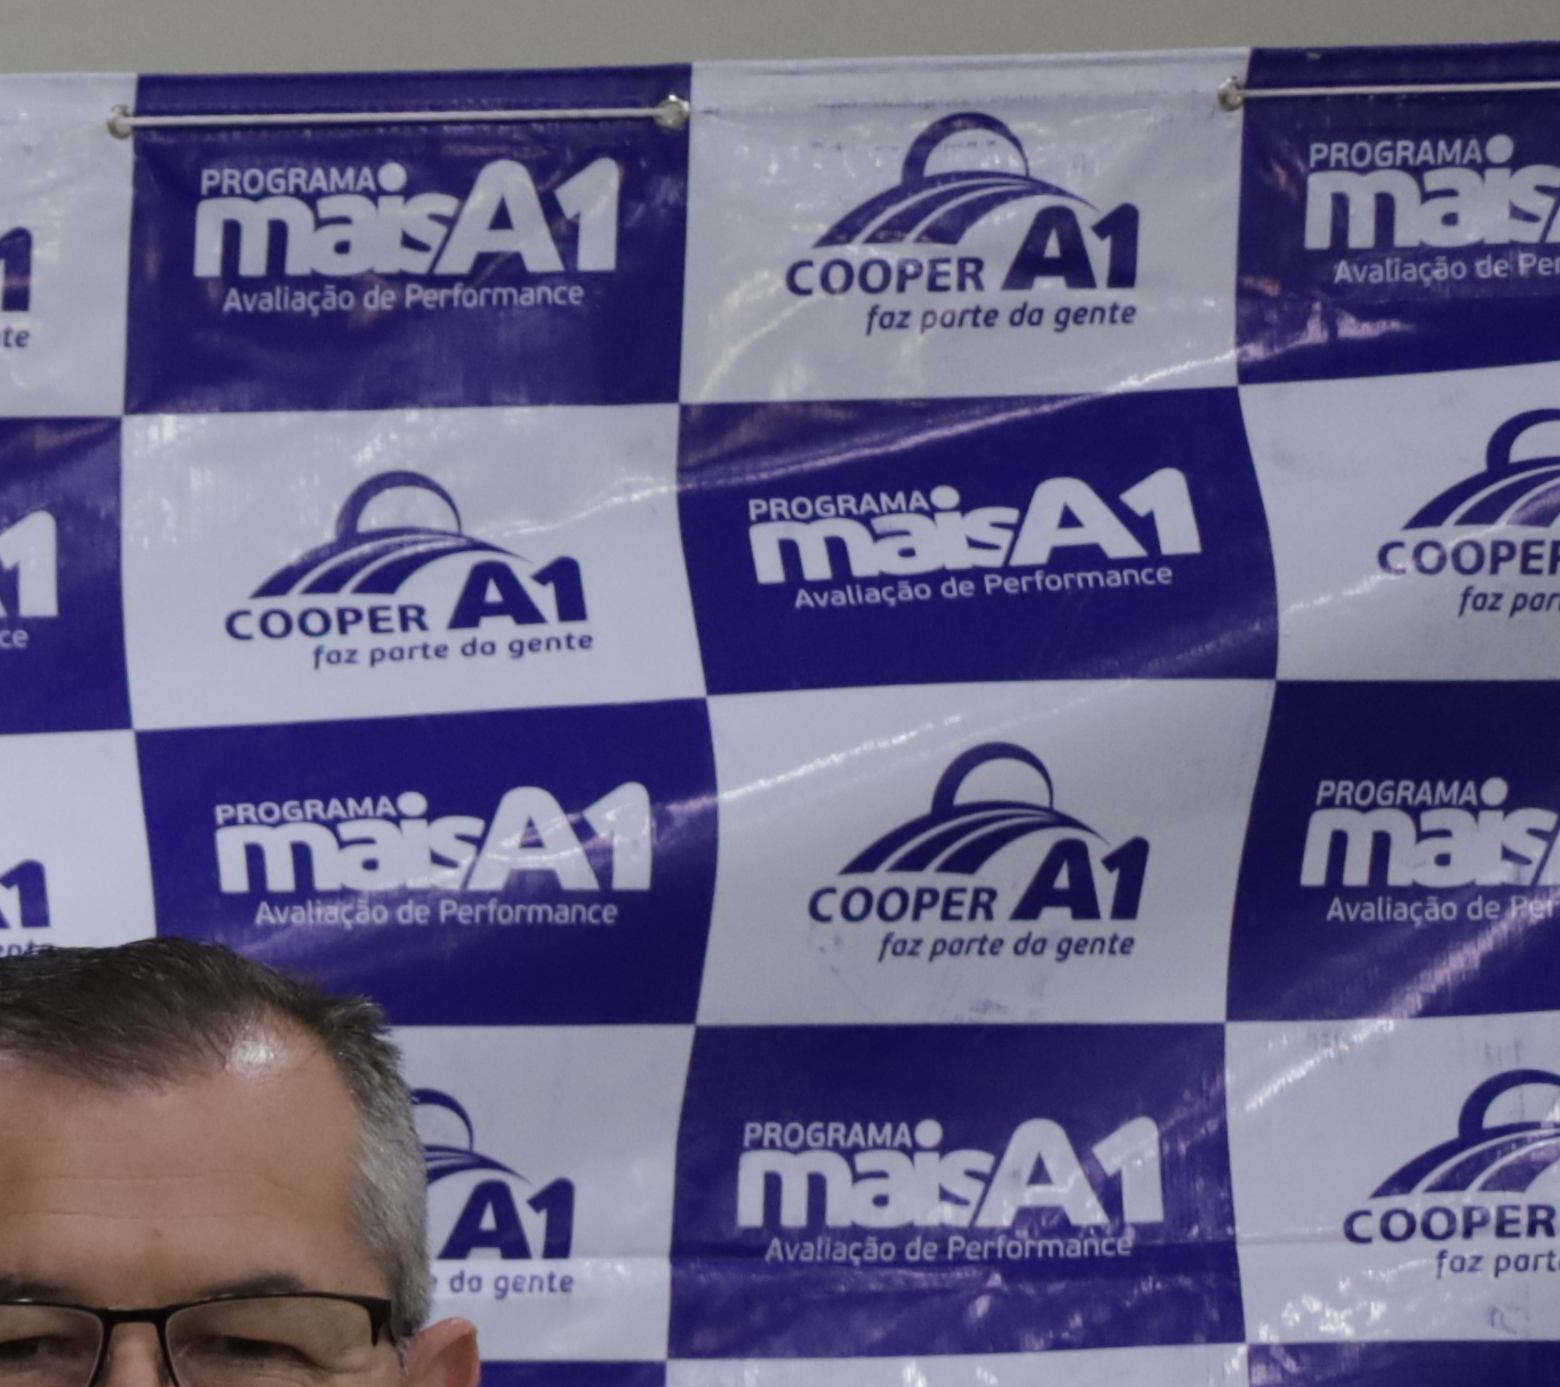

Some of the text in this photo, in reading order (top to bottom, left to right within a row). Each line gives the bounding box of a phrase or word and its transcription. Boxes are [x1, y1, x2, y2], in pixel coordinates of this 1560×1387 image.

[201, 168, 376, 196] PROGRAMA
[223, 281, 585, 317] Avaliação de Performance
